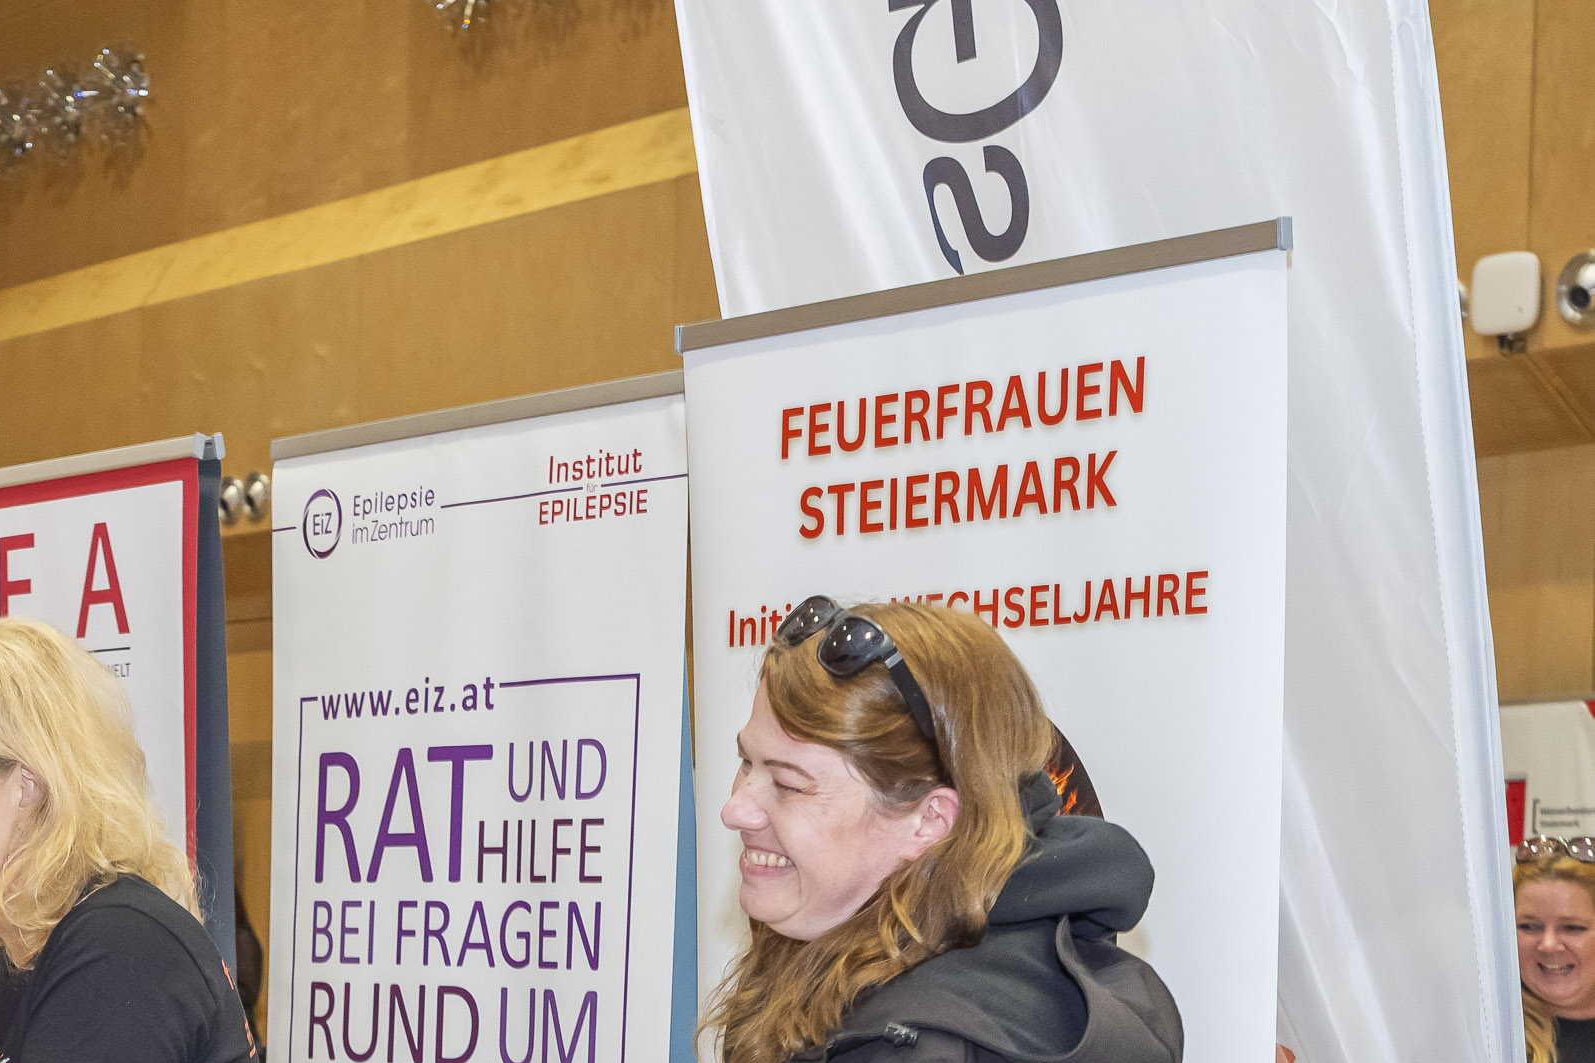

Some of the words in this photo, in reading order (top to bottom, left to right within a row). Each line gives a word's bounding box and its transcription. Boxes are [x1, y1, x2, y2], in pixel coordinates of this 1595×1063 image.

[781, 356, 1146, 461] FEUERFRAUEN
[548, 448, 643, 485] Institut
[798, 450, 1118, 540] STEIERMARK
[352, 486, 436, 518] Epilepsie
[538, 489, 649, 526] EPILEPSIE
[321, 677, 495, 721] www.eiz.at
[314, 744, 494, 884] RAT
[508, 738, 608, 803] UND
[477, 818, 605, 885] HILFE
[311, 900, 376, 966] BEI
[396, 900, 602, 971] FRAGEN
